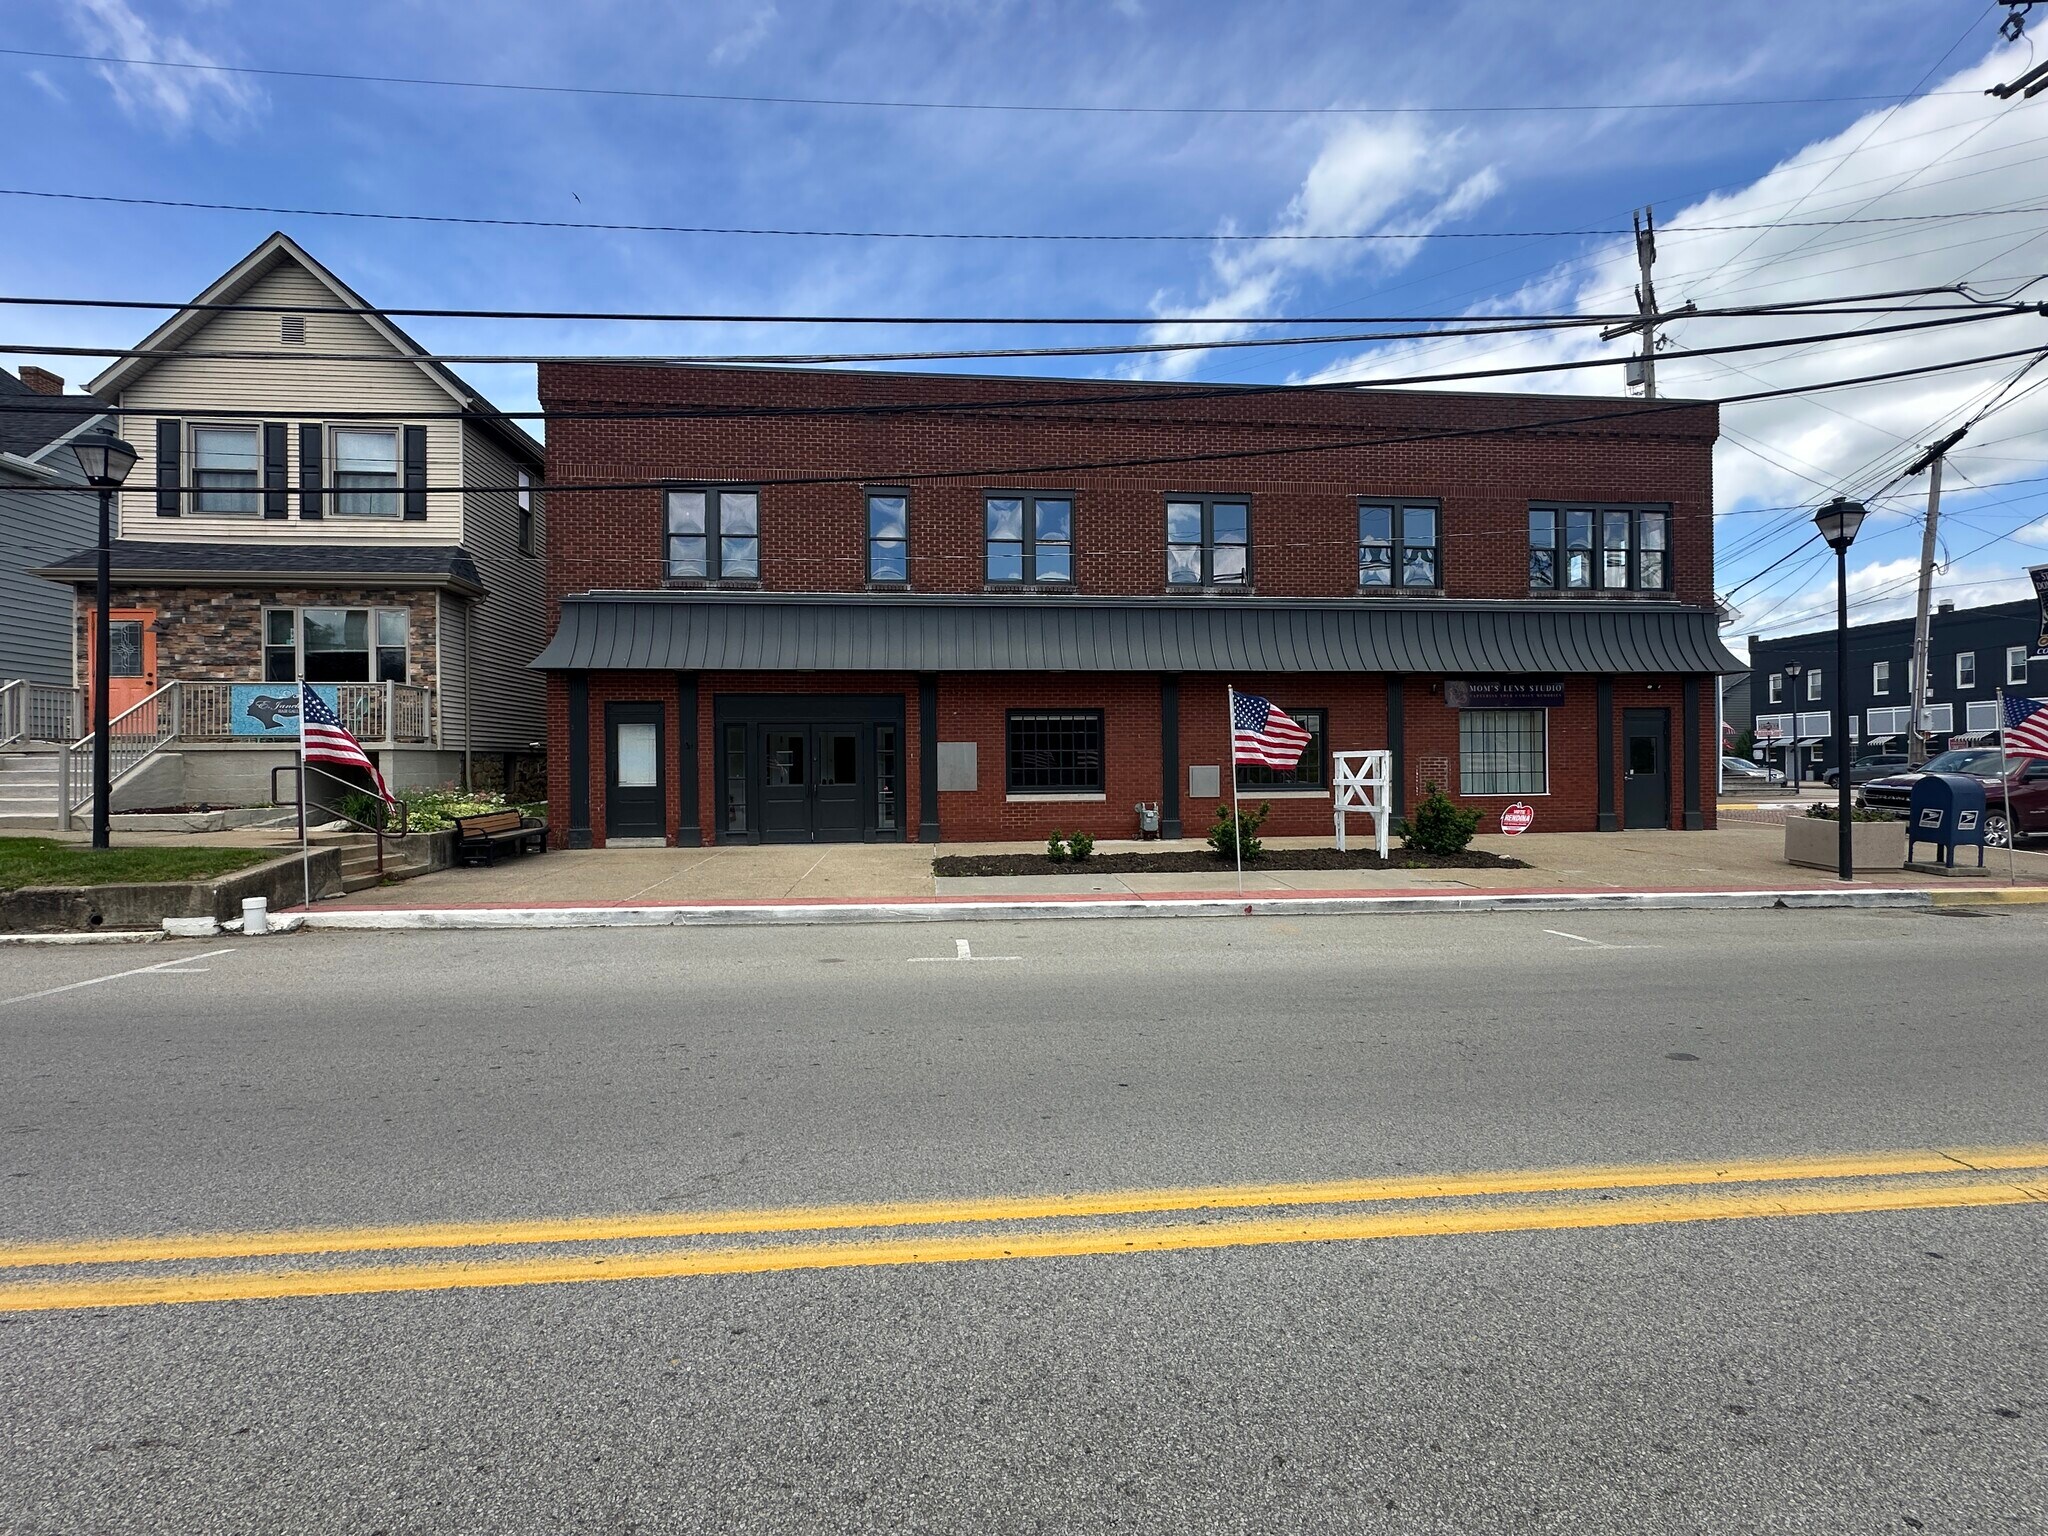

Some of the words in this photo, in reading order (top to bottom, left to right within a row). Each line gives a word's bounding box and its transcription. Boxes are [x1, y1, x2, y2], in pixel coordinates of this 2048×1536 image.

[1469, 684, 1500, 692] MOM'S
[1503, 684, 1525, 692] LENS
[1529, 684, 1562, 692] STUDIO
